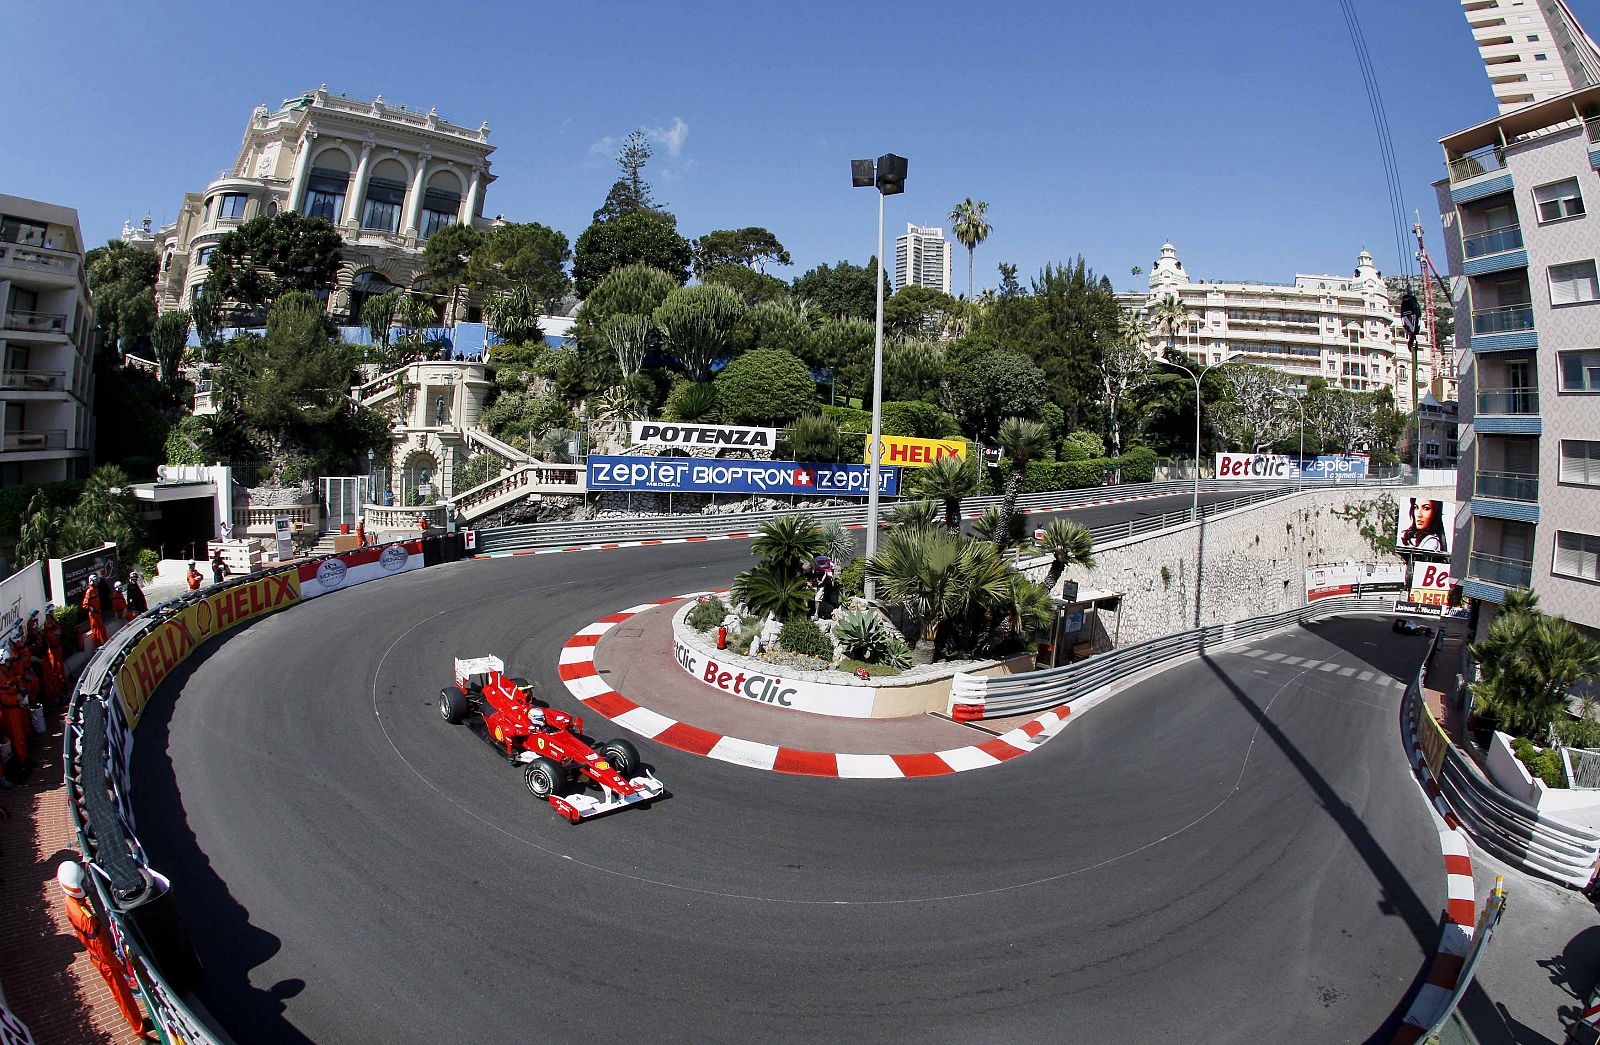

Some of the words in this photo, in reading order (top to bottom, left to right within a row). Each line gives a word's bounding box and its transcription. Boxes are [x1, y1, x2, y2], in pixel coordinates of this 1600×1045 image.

[640, 426, 768, 446] POTENZA
[593, 462, 689, 486] zepter
[693, 466, 795, 490] BIOPTRON
[1220, 456, 1288, 476] BetClic
[1306, 457, 1361, 478] zepter
[466, 533, 474, 547] F
[1422, 566, 1455, 588] Be
[214, 575, 299, 629] HELIX
[1421, 607, 1440, 615] WALKER
[133, 616, 196, 701] HELIX
[703, 660, 798, 706] BetClic
